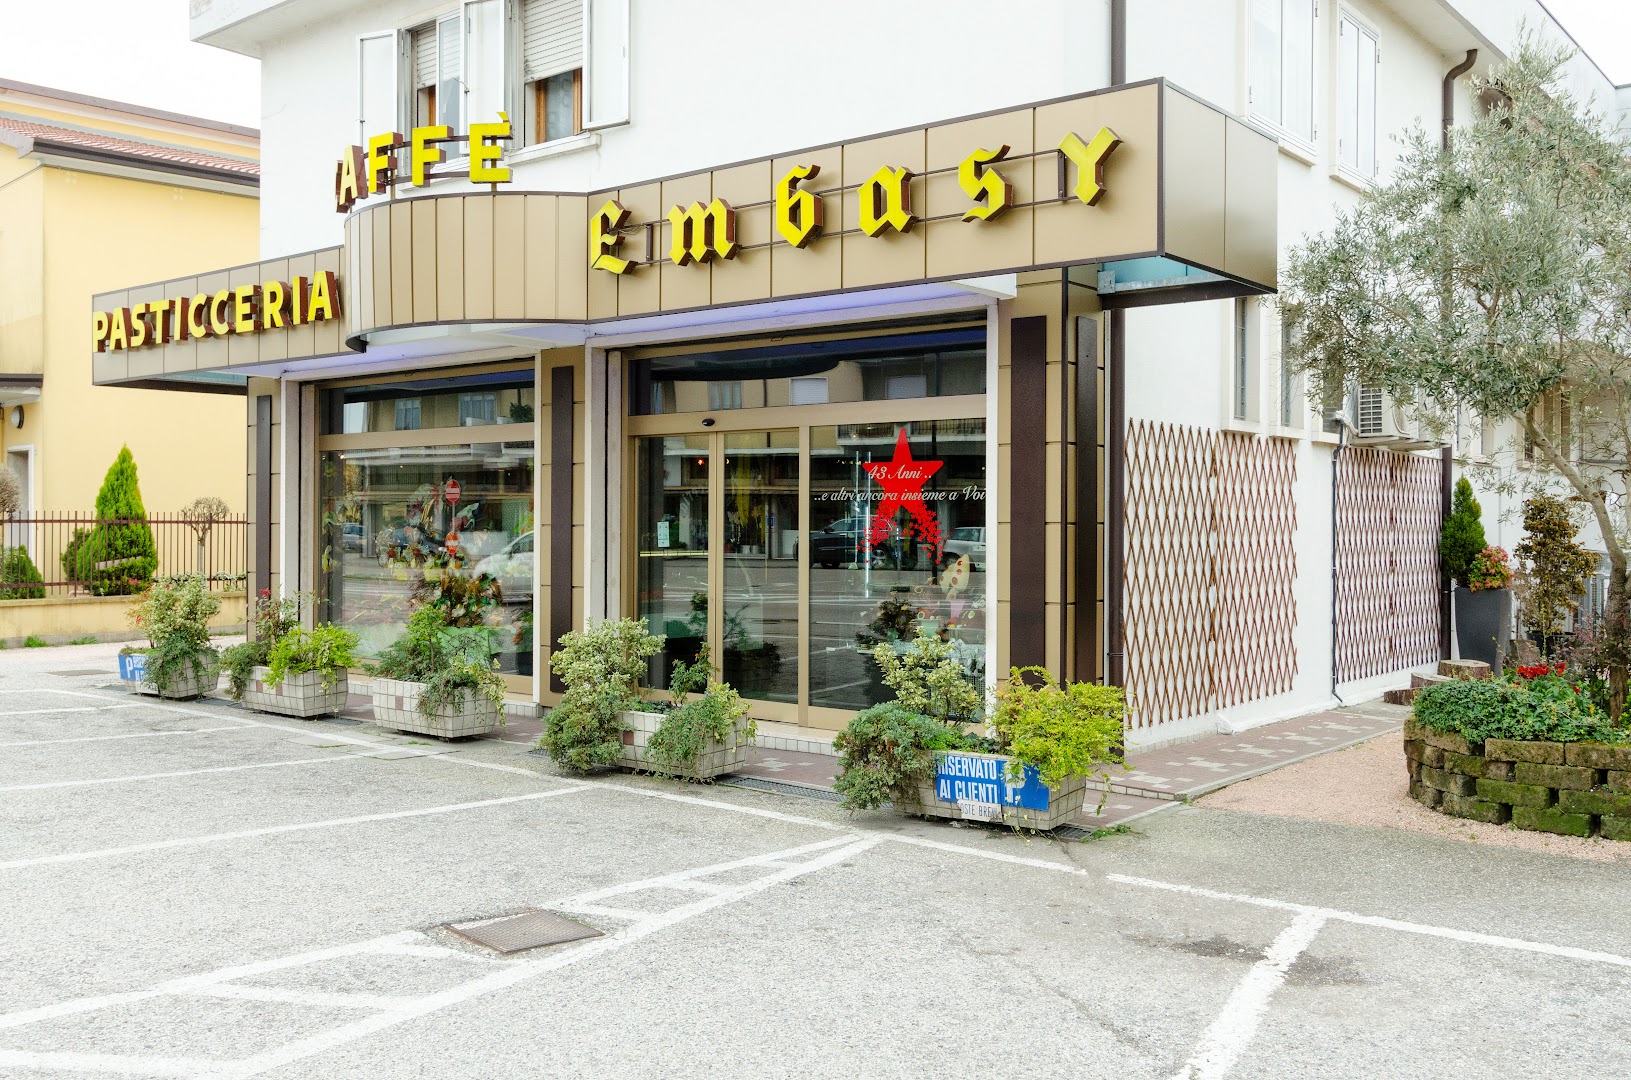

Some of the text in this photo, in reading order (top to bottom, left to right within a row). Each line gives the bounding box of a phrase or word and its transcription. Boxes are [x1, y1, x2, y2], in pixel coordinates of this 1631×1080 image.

[336, 111, 513, 213] AFFÈ
[92, 270, 341, 353] PASTICCERIA
[868, 466, 887, 480] 43
[831, 487, 857, 501] altri
[857, 491, 899, 501] ancora
[901, 488, 947, 501] insieme
[949, 491, 960, 501] a
[125, 656, 134, 679] P
[940, 779, 999, 804] AI CLIENTI
[957, 803, 976, 816] OSTE
